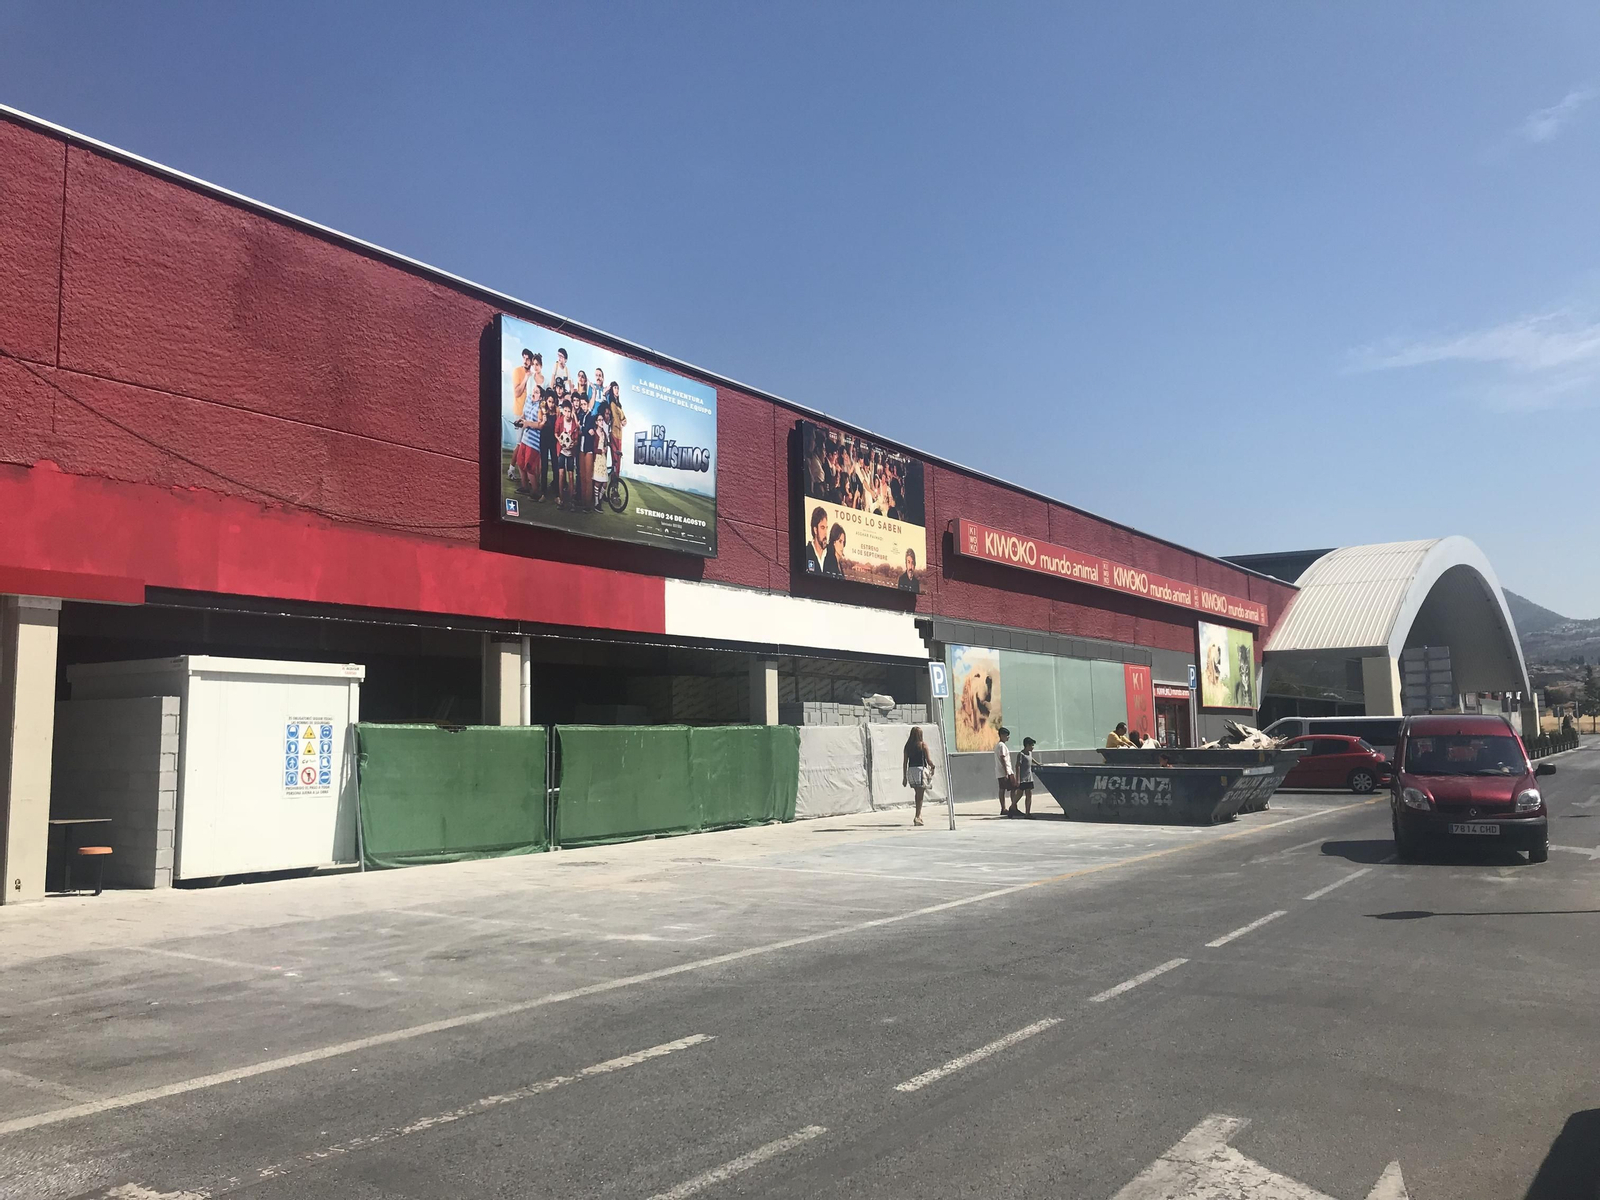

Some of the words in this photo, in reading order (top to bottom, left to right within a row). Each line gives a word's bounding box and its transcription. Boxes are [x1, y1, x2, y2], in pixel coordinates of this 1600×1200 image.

[642, 388, 655, 397] SER
[656, 392, 676, 404] PARTE
[677, 399, 689, 408] DEL
[690, 403, 712, 415] EQUIPO
[649, 381, 671, 394] MAYOR
[672, 390, 703, 405] AVENTURA
[652, 425, 666, 440] LOS
[636, 508, 664, 519] ESTRENO
[683, 517, 706, 527] AGOSTO
[835, 510, 862, 524] TODOS
[865, 517, 875, 527] LO
[878, 521, 902, 534] SABEN
[861, 544, 879, 552] ESTRENO
[864, 551, 888, 560] SEPTIEMBRE
[985, 531, 1036, 565] KIWOKO
[1040, 554, 1071, 575] mundo
[1073, 560, 1098, 581] animal
[1114, 566, 1148, 593] KIWOKO
[1150, 583, 1172, 600] mundo
[1173, 588, 1191, 604] animal
[1201, 591, 1227, 613] KIWOKO
[1228, 603, 1245, 617] mundo
[1245, 607, 1259, 621] animal
[933, 666, 944, 693] P
[1132, 672, 1143, 690] KI
[1190, 668, 1195, 686] P
[1131, 792, 1149, 806] 33
[1154, 792, 1172, 806] 44
